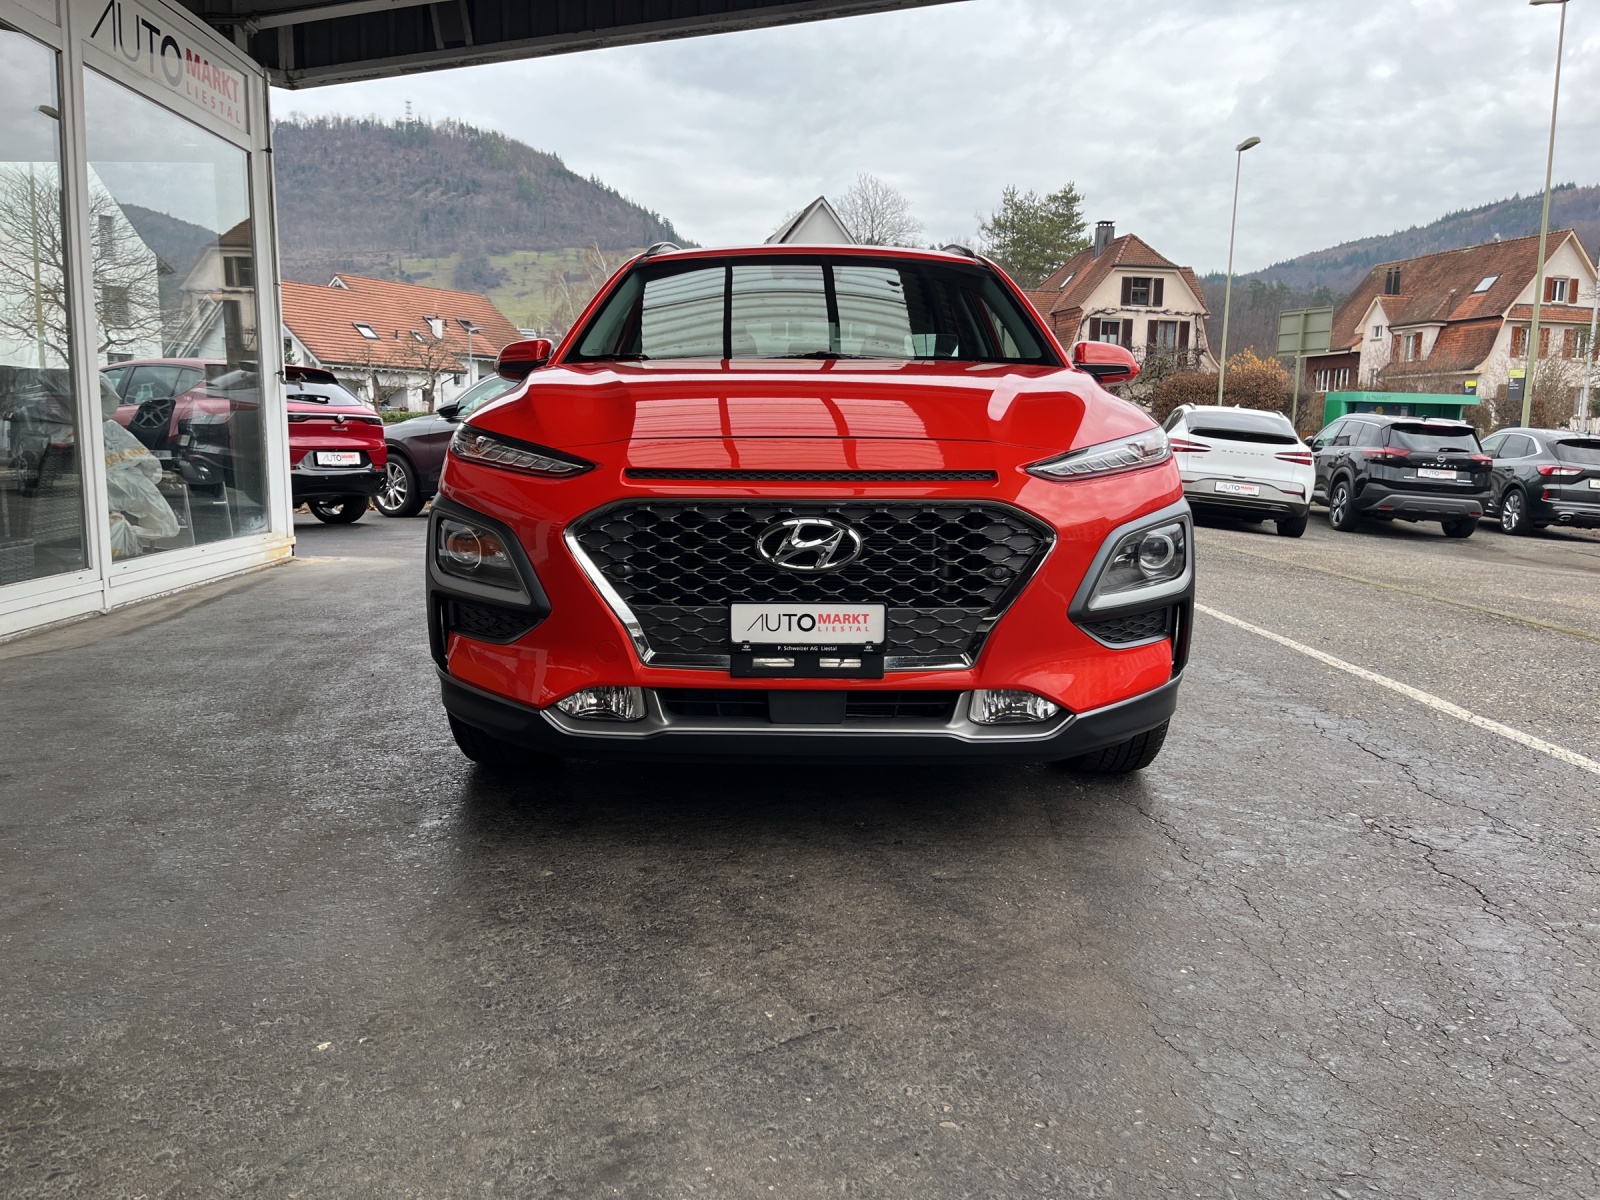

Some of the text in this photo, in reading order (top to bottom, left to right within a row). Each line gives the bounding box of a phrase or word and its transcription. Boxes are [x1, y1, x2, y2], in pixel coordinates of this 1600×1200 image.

[90, 0, 239, 104] AUTO MARKT
[186, 80, 241, 125] LIESTAL
[746, 613, 870, 632] AUTO MARKT
